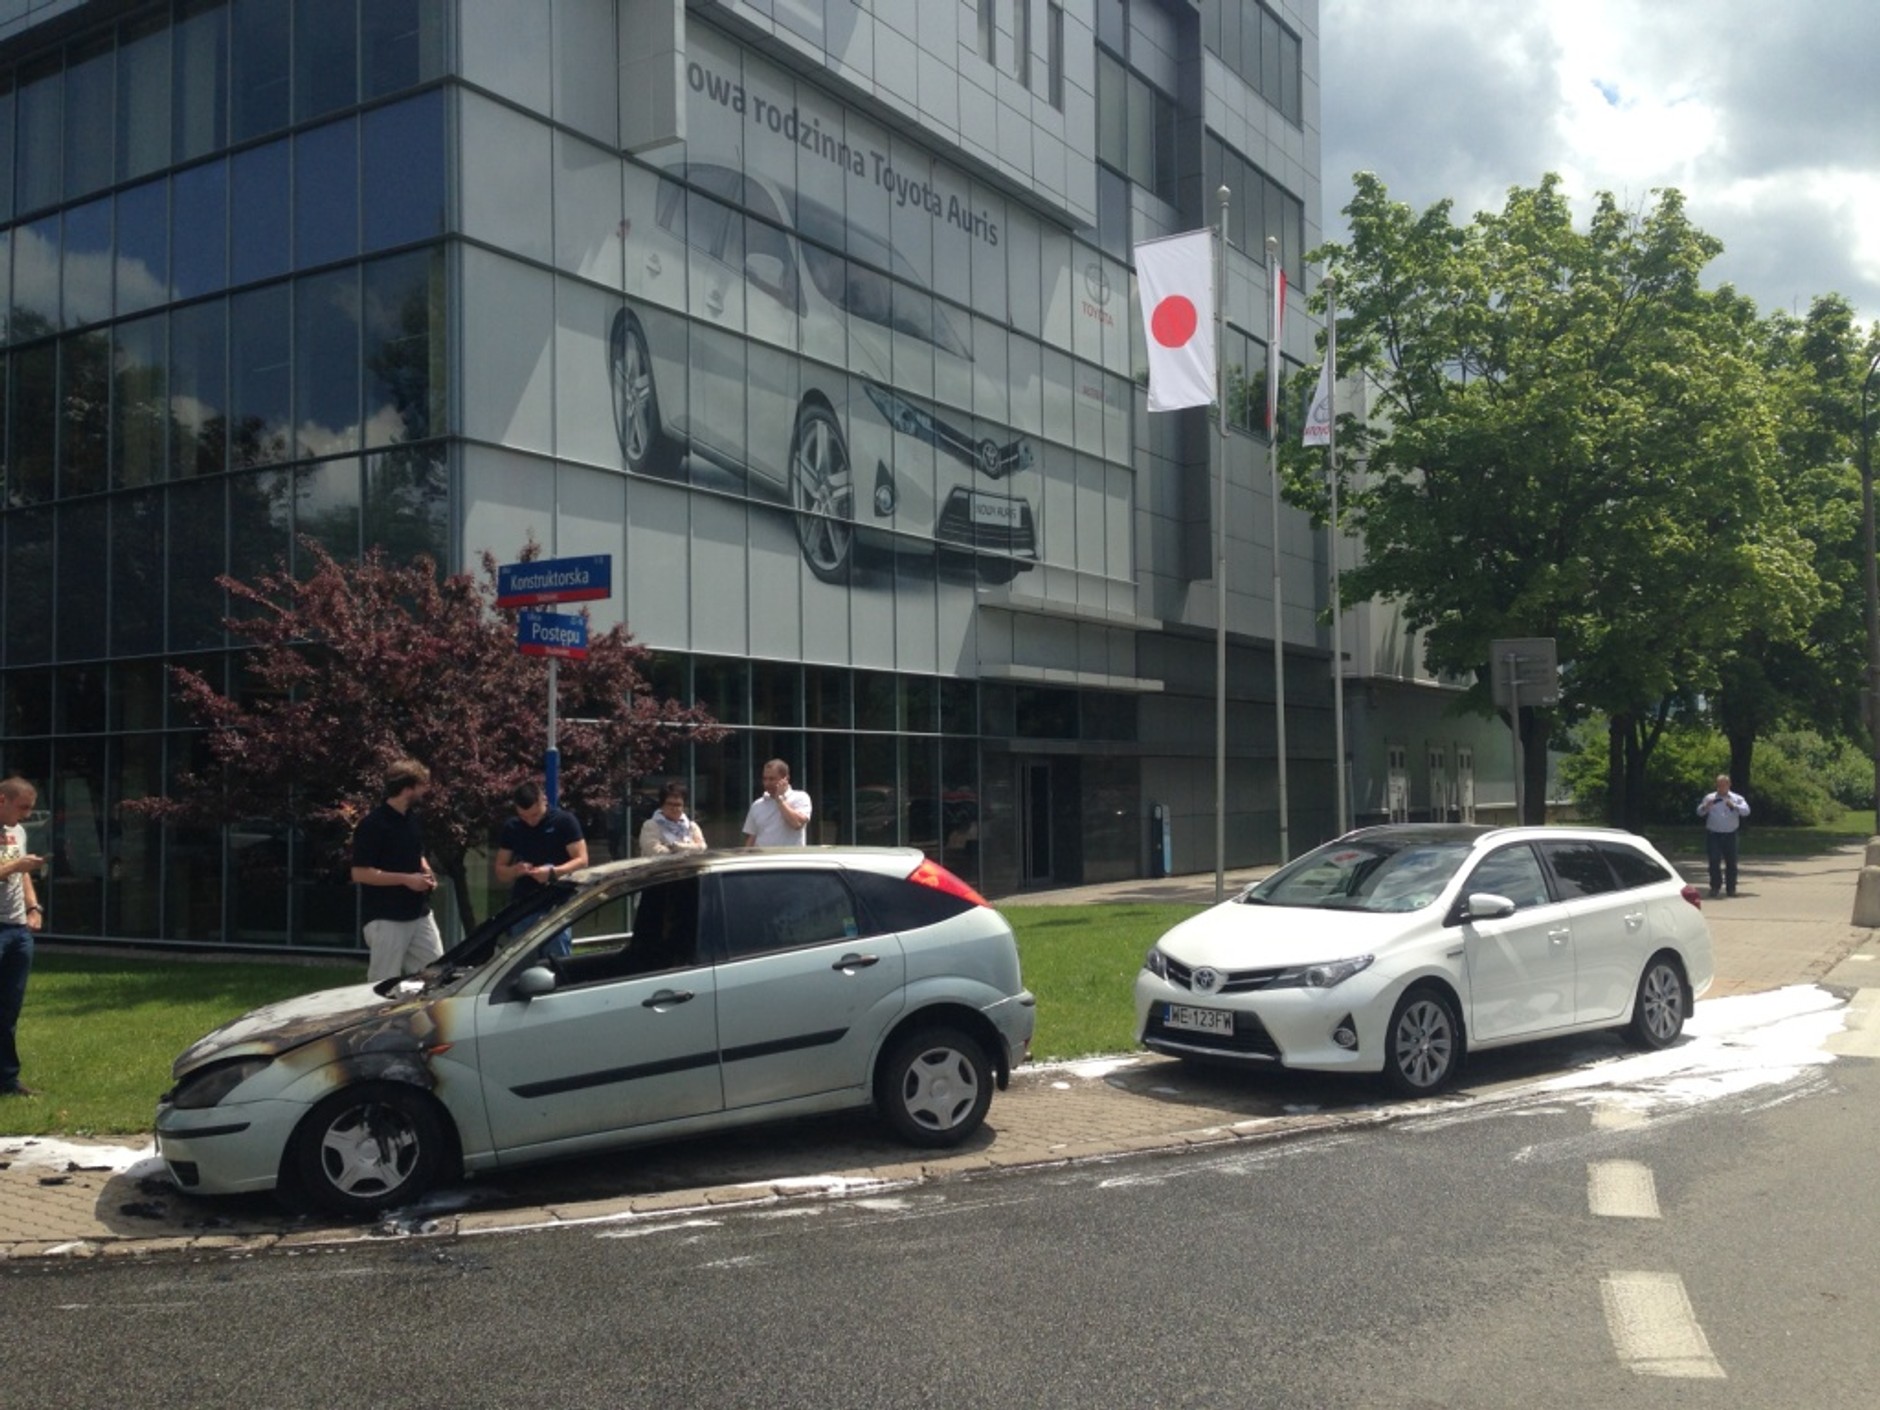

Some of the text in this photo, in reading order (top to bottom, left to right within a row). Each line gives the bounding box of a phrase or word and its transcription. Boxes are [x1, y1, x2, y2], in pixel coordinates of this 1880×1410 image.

[687, 61, 999, 246] owa rodzinna Toyota Auris
[1082, 301, 1114, 326] TOYOTA
[510, 568, 589, 591] Konstruktorska
[532, 623, 580, 646] Postępu
